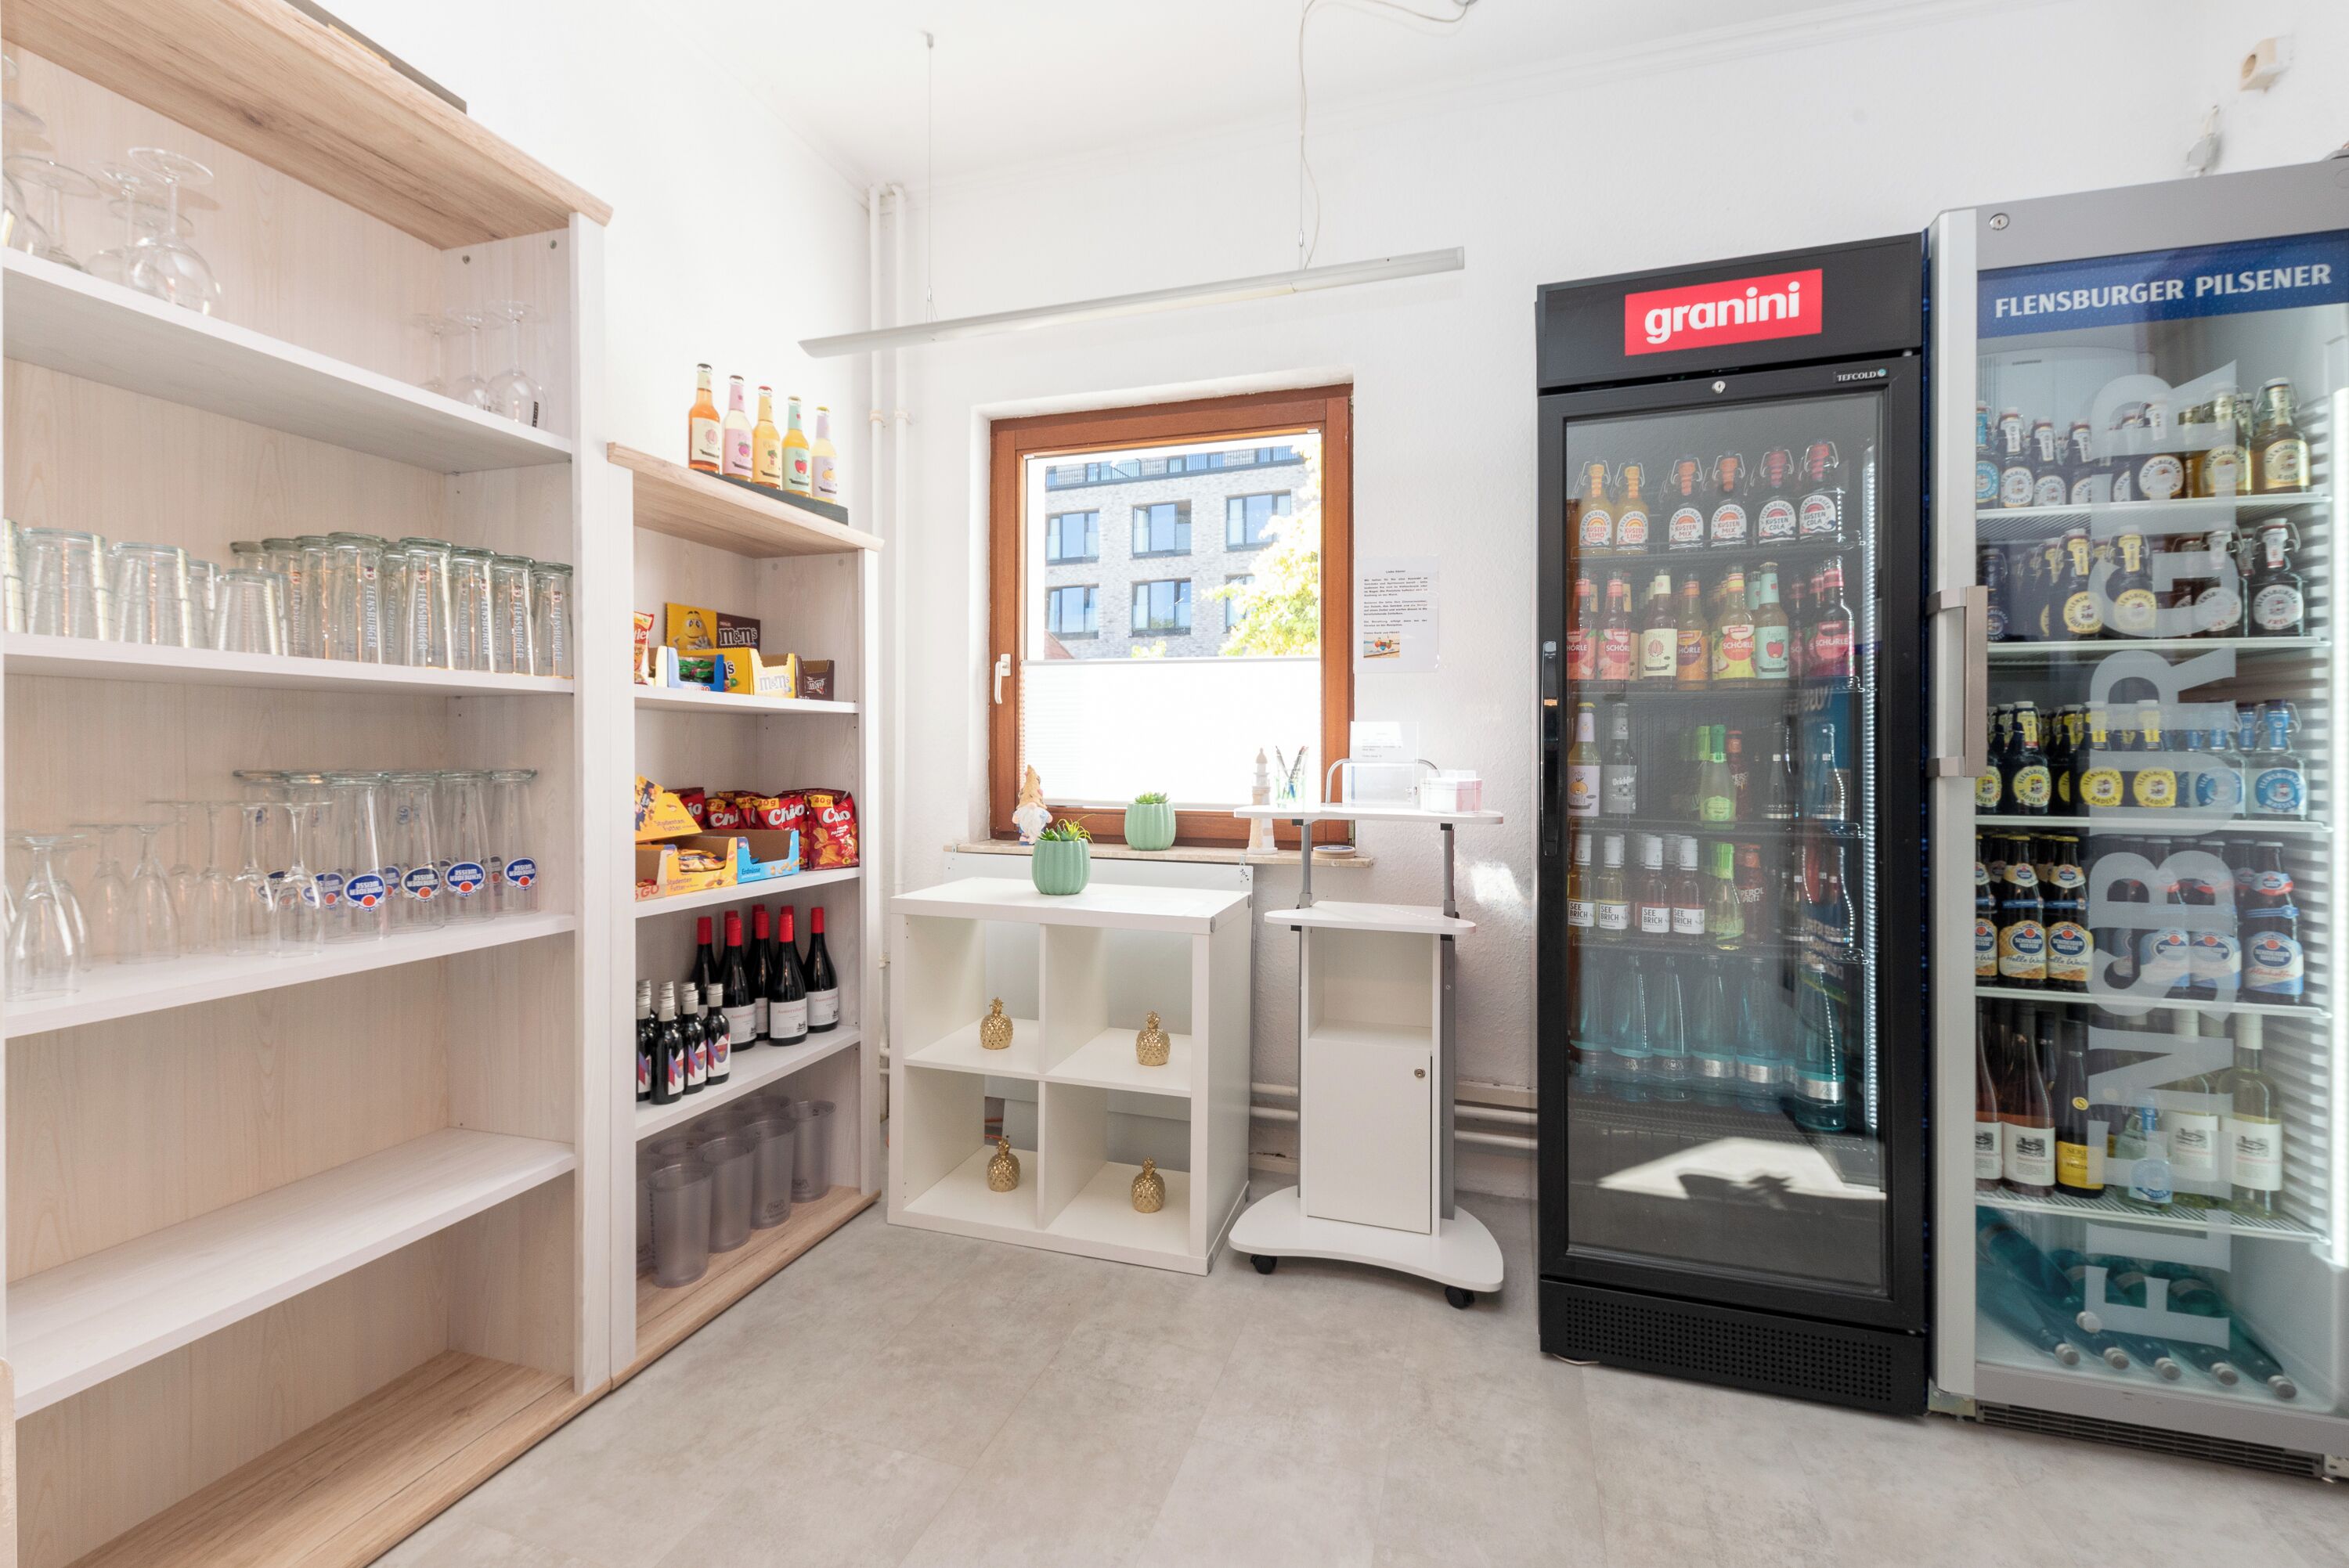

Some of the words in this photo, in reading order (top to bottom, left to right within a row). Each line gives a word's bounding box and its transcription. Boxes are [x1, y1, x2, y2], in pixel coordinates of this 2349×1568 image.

[1995, 278, 2185, 319] FLENSBURGER
[2195, 263, 2333, 298] PILSENER
[1644, 280, 1800, 344] granini
[1836, 371, 1877, 382] TEFCOLD
[366, 585, 377, 647] FLENSBURGER
[417, 588, 428, 651] FLENSBURGER
[514, 601, 524, 659] FLENSBURGER
[1723, 641, 1754, 650] SCHORLE
[1815, 638, 1849, 647] SCHORLE
[2091, 795, 2118, 805] RADLER
[2265, 800, 2297, 810] WASSER
[710, 809, 739, 827] Chi
[767, 802, 805, 827] Chio
[741, 867, 761, 876] Erdnüsse
[449, 873, 482, 882] SCHNEIDER
[1569, 910, 1588, 918] BRICH
[1600, 912, 1619, 921] BRICH
[1644, 908, 1655, 917] SEE
[1673, 908, 1684, 917] SEE
[1643, 915, 1663, 924] BRICH
[1673, 916, 1692, 925] BRICH
